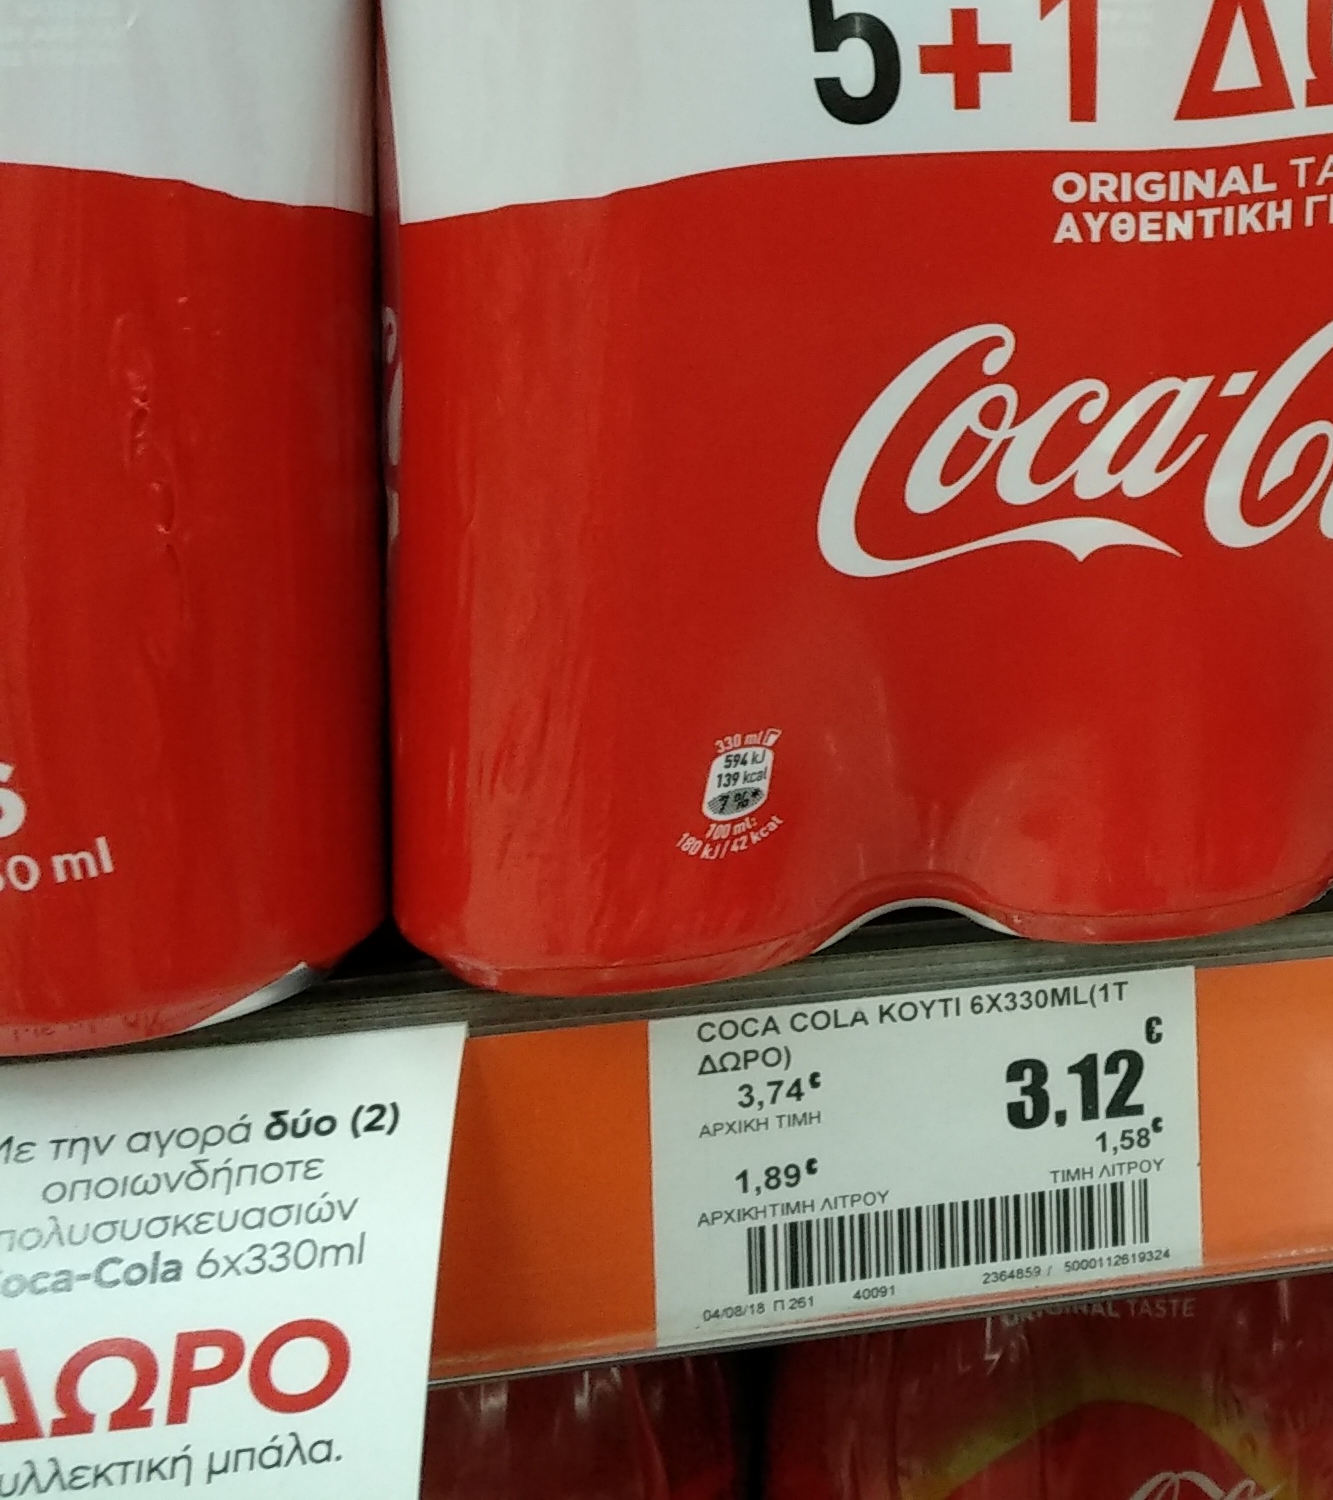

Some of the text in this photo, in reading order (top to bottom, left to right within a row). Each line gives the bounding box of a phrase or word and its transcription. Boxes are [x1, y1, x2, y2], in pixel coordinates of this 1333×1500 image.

[1053, 169, 1276, 204] ORIGINAL
[1053, 198, 1293, 244] ΑΥΘΕΝΤΙΚΗ
[723, 751, 749, 769] 594
[716, 771, 740, 788] 139
[698, 1015, 780, 1042] COCA
[790, 1010, 869, 1034] COLA
[698, 1044, 791, 1076] ΔΩΡΟ)
[49, 1137, 114, 1165] την
[126, 1114, 252, 1158] αγορά
[265, 1108, 337, 1142] δύο
[351, 1102, 400, 1139] (2)
[0, 1232, 366, 1298] oca-Cola 6x330ml
[0, 1445, 193, 1498] υλλεκτική
